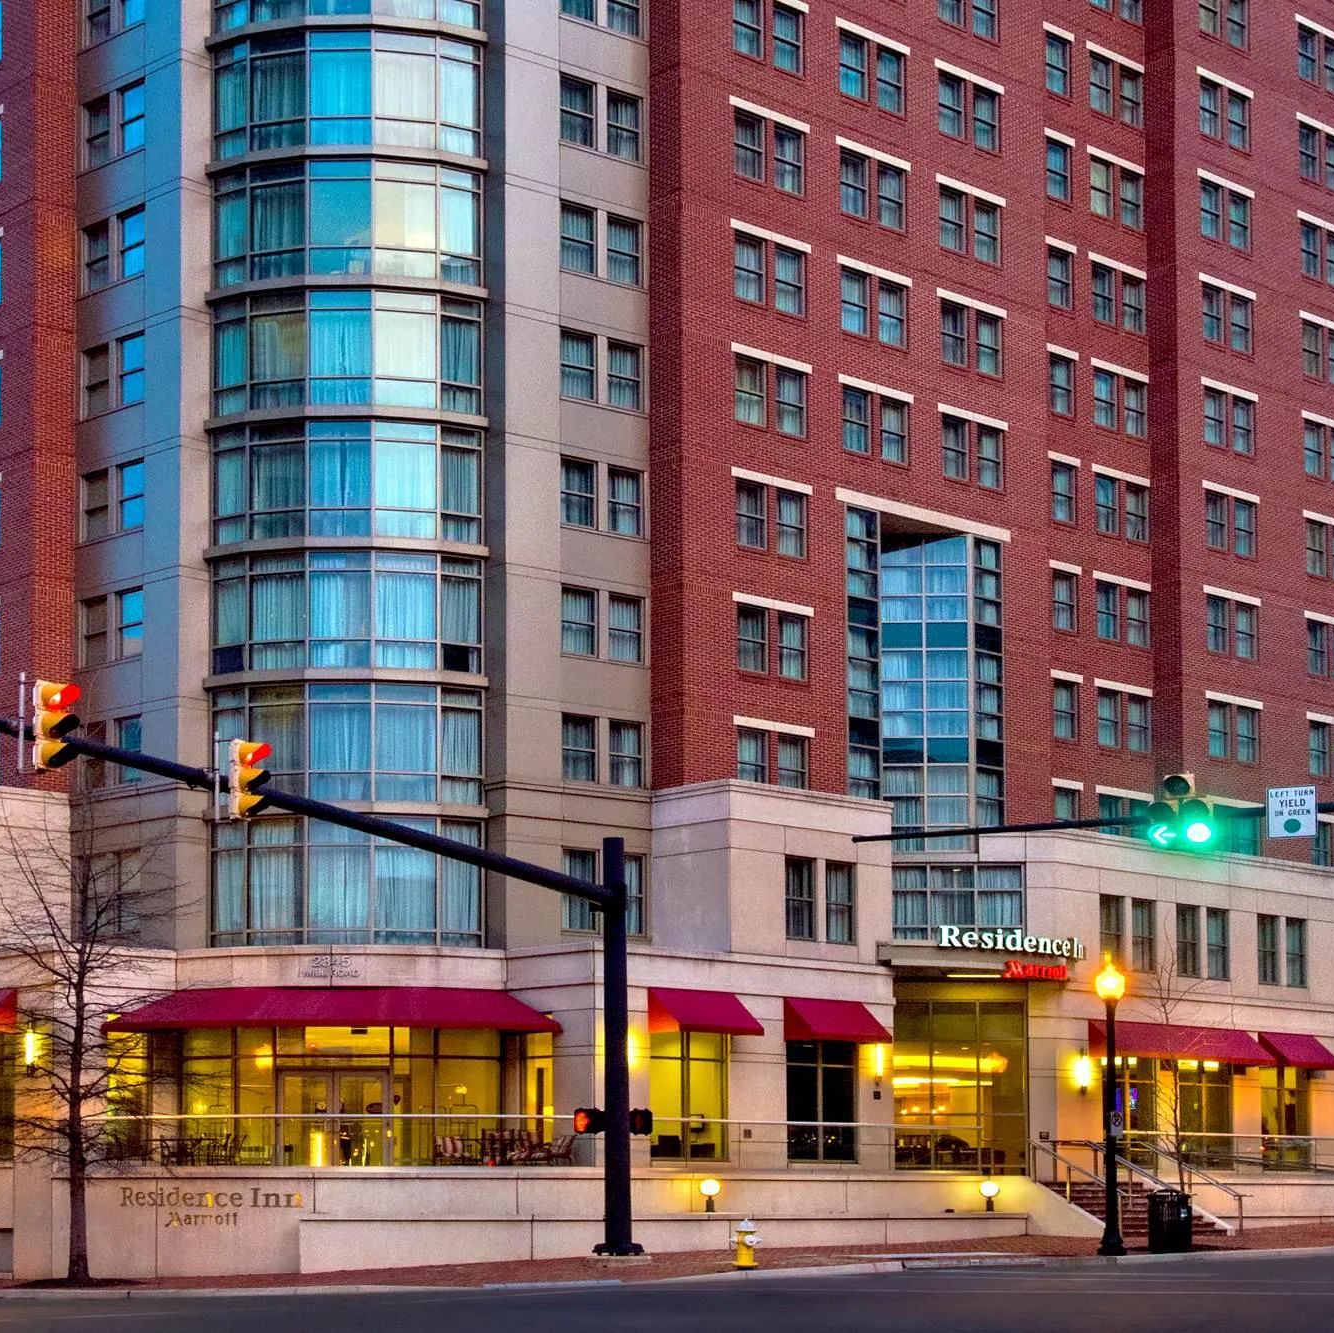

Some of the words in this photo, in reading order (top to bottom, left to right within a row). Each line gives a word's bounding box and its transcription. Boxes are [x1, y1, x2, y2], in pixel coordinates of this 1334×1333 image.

[1270, 790, 1289, 798] LEFT
[1279, 798, 1306, 808] YIELD
[1288, 808, 1311, 816] GREEN
[939, 924, 1071, 957] Residence
[331, 969, 360, 978] ROAD
[120, 1187, 243, 1208] Residence
[250, 1187, 304, 1208] Inn
[164, 1211, 239, 1228] Marriott
